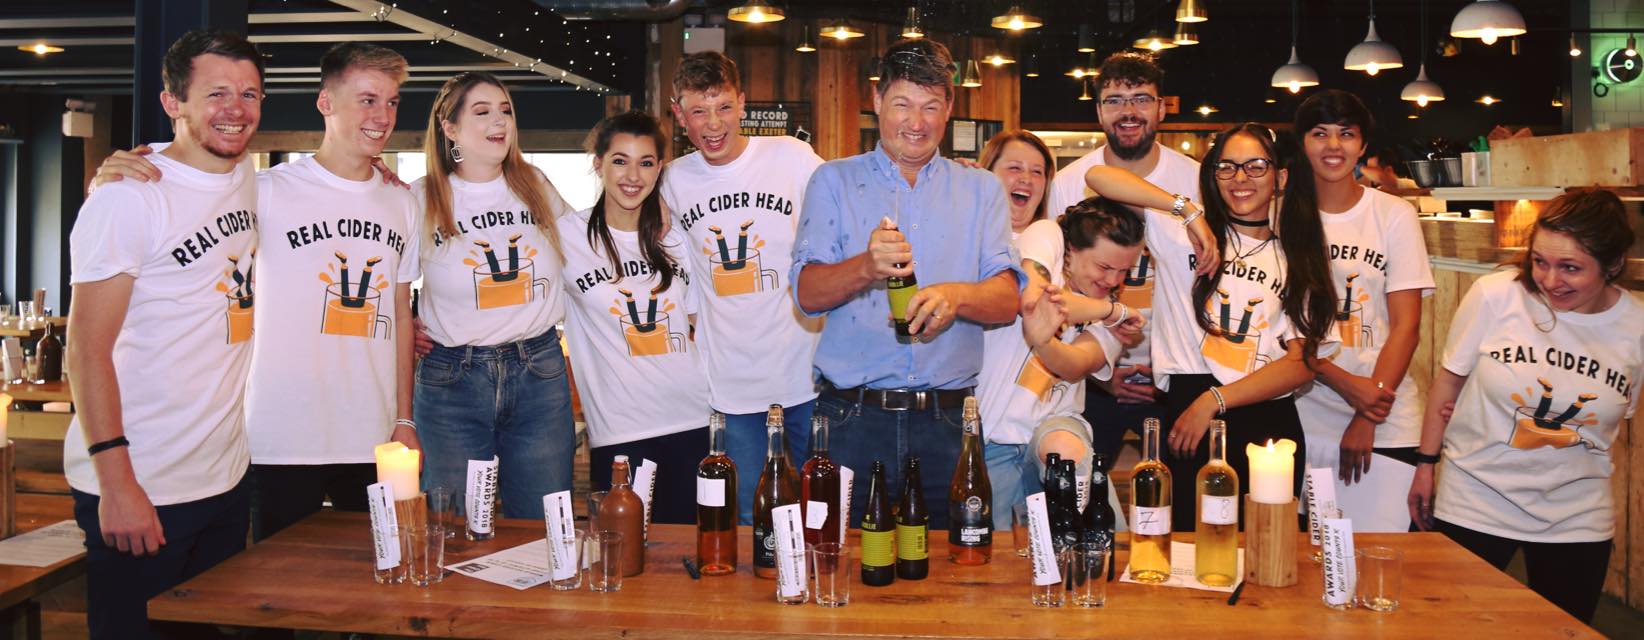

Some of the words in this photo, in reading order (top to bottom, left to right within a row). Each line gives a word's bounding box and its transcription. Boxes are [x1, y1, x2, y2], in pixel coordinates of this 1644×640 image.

[751, 111, 788, 120] RECORD
[472, 211, 515, 230] CIDER
[681, 204, 705, 232] REAL
[709, 192, 750, 213] CIDER
[756, 192, 793, 216] HEAD
[171, 226, 219, 267] REAL
[217, 209, 251, 238] CIDER
[286, 221, 333, 250] REAL
[337, 218, 382, 243] CIDER
[1330, 244, 1359, 260] DER
[576, 267, 613, 293] REAL
[671, 263, 690, 286] EAD
[1546, 347, 1600, 379] CIDER
[484, 467, 492, 505] AWARDS
[1139, 511, 1159, 530] 7
[1311, 511, 1321, 541] CIDER
[1325, 551, 1335, 597] AWARDS
